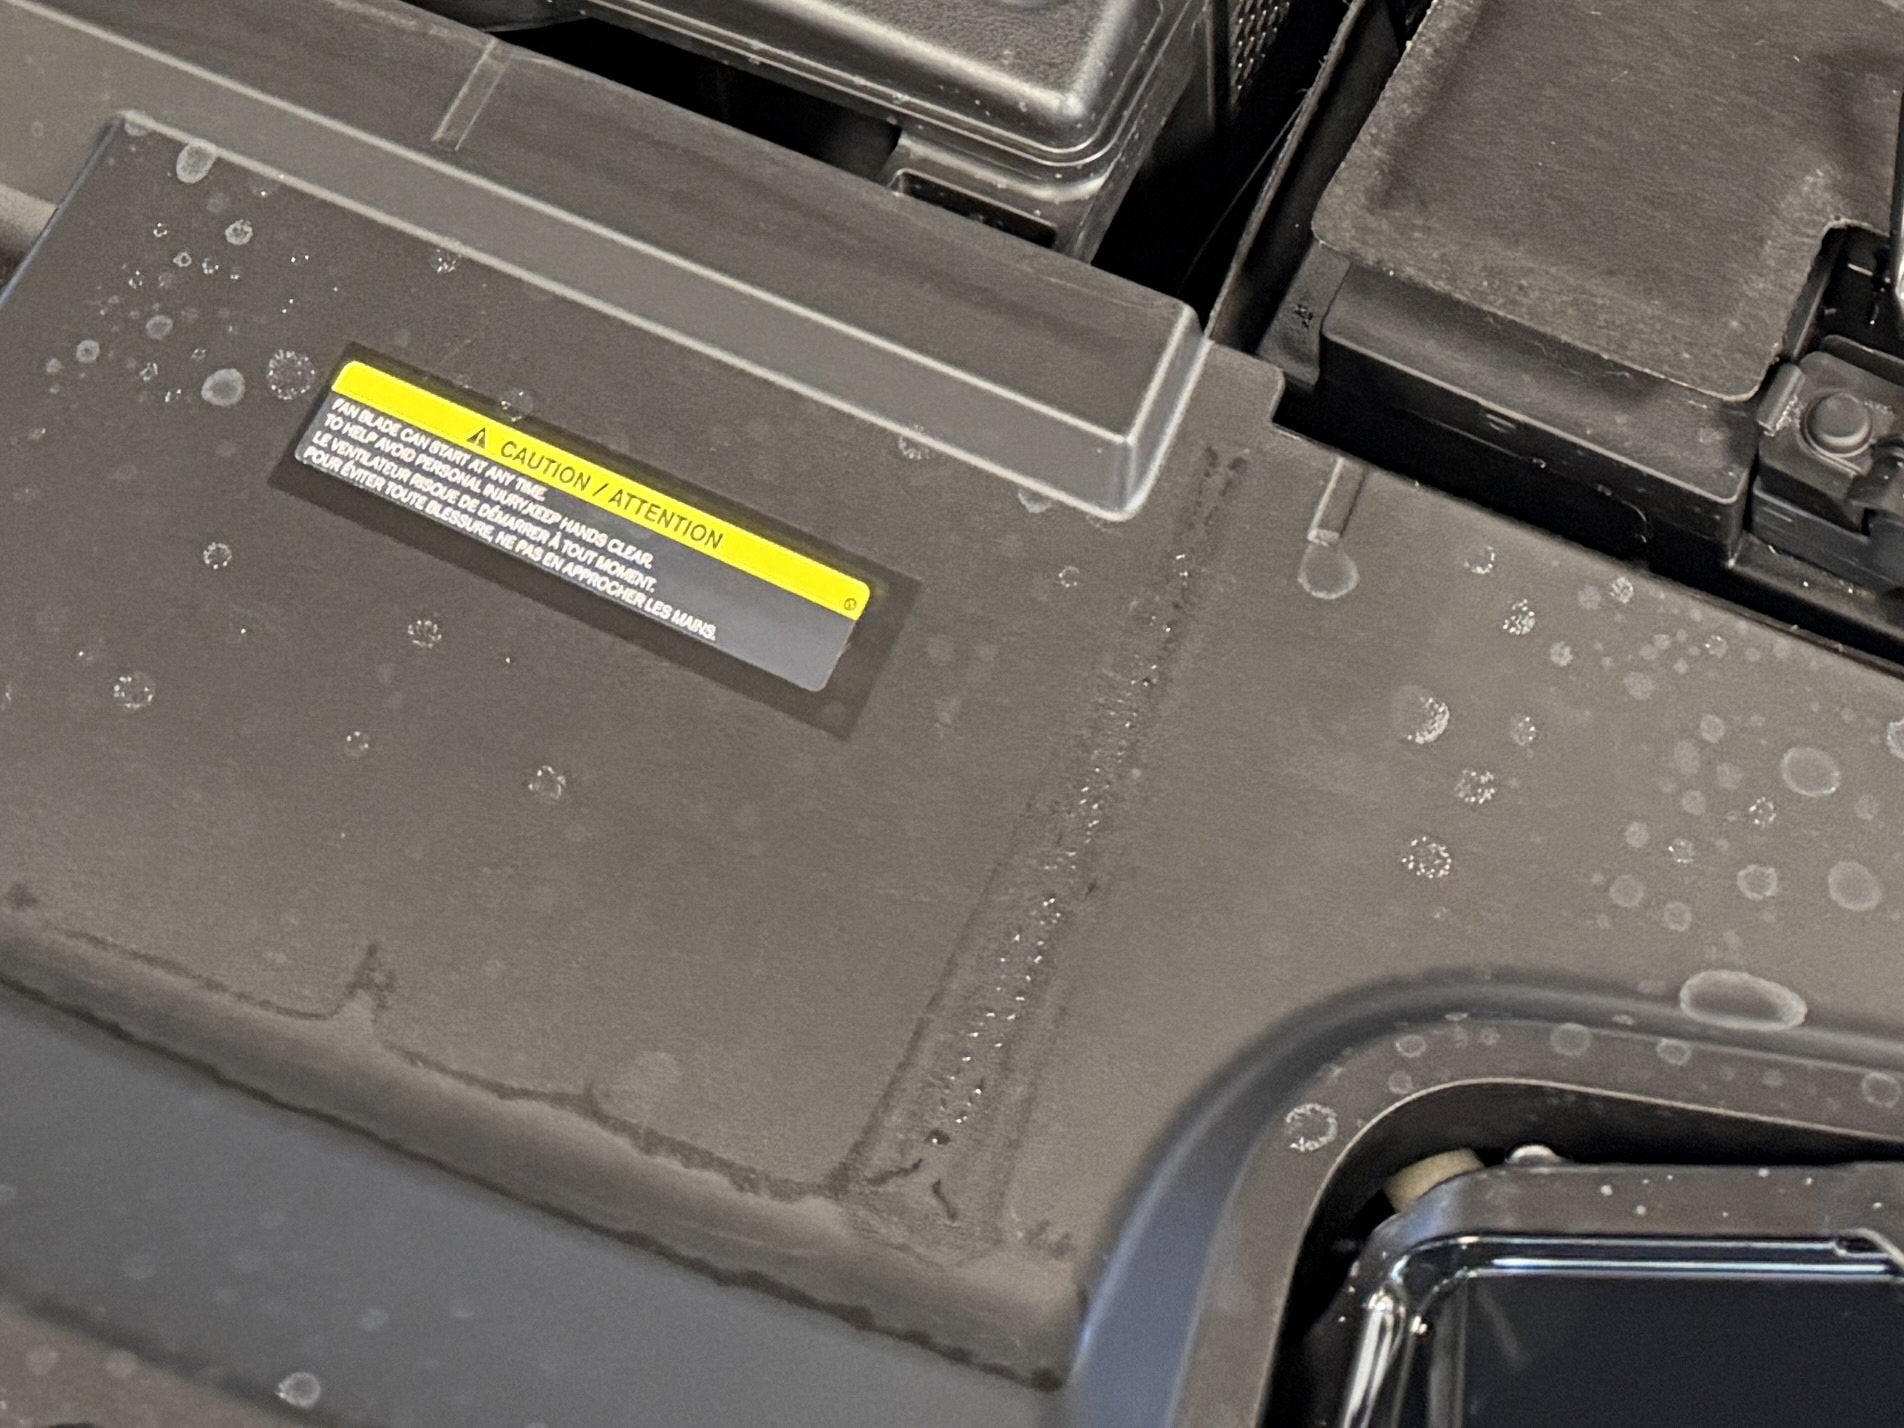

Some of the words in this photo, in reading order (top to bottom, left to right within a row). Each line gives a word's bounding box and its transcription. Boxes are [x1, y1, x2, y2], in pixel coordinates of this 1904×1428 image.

[324, 413, 345, 431] TO
[345, 422, 379, 444] HELP
[376, 436, 416, 462] AVOID
[414, 452, 481, 493] PERSONAL
[559, 515, 609, 549] HANDS
[331, 397, 363, 420] FAN
[359, 408, 399, 437] BLADE
[400, 426, 433, 450] CAN
[429, 440, 472, 467] START
[469, 456, 489, 473] AT
[486, 463, 517, 486] ANY
[500, 440, 592, 492] CAUTION
[592, 483, 609, 497] /
[607, 488, 724, 550] ATTENTION
[302, 446, 341, 474] POUR
[339, 459, 387, 493] ÉVITER
[385, 482, 425, 510] TOUTE
[425, 497, 494, 543] BLESSURE,
[496, 530, 518, 549] NE
[515, 539, 544, 562] PAS
[542, 552, 566, 572] EN
[562, 560, 648, 609] APPROCHER
[645, 597, 673, 621] LES
[311, 430, 332, 447] LE
[330, 437, 412, 482] VENTILATEUR
[409, 472, 459, 505] RISQUE
[458, 494, 479, 511] DE
[561, 539, 598, 565] TOUT
[595, 554, 657, 593] MOMENT.
